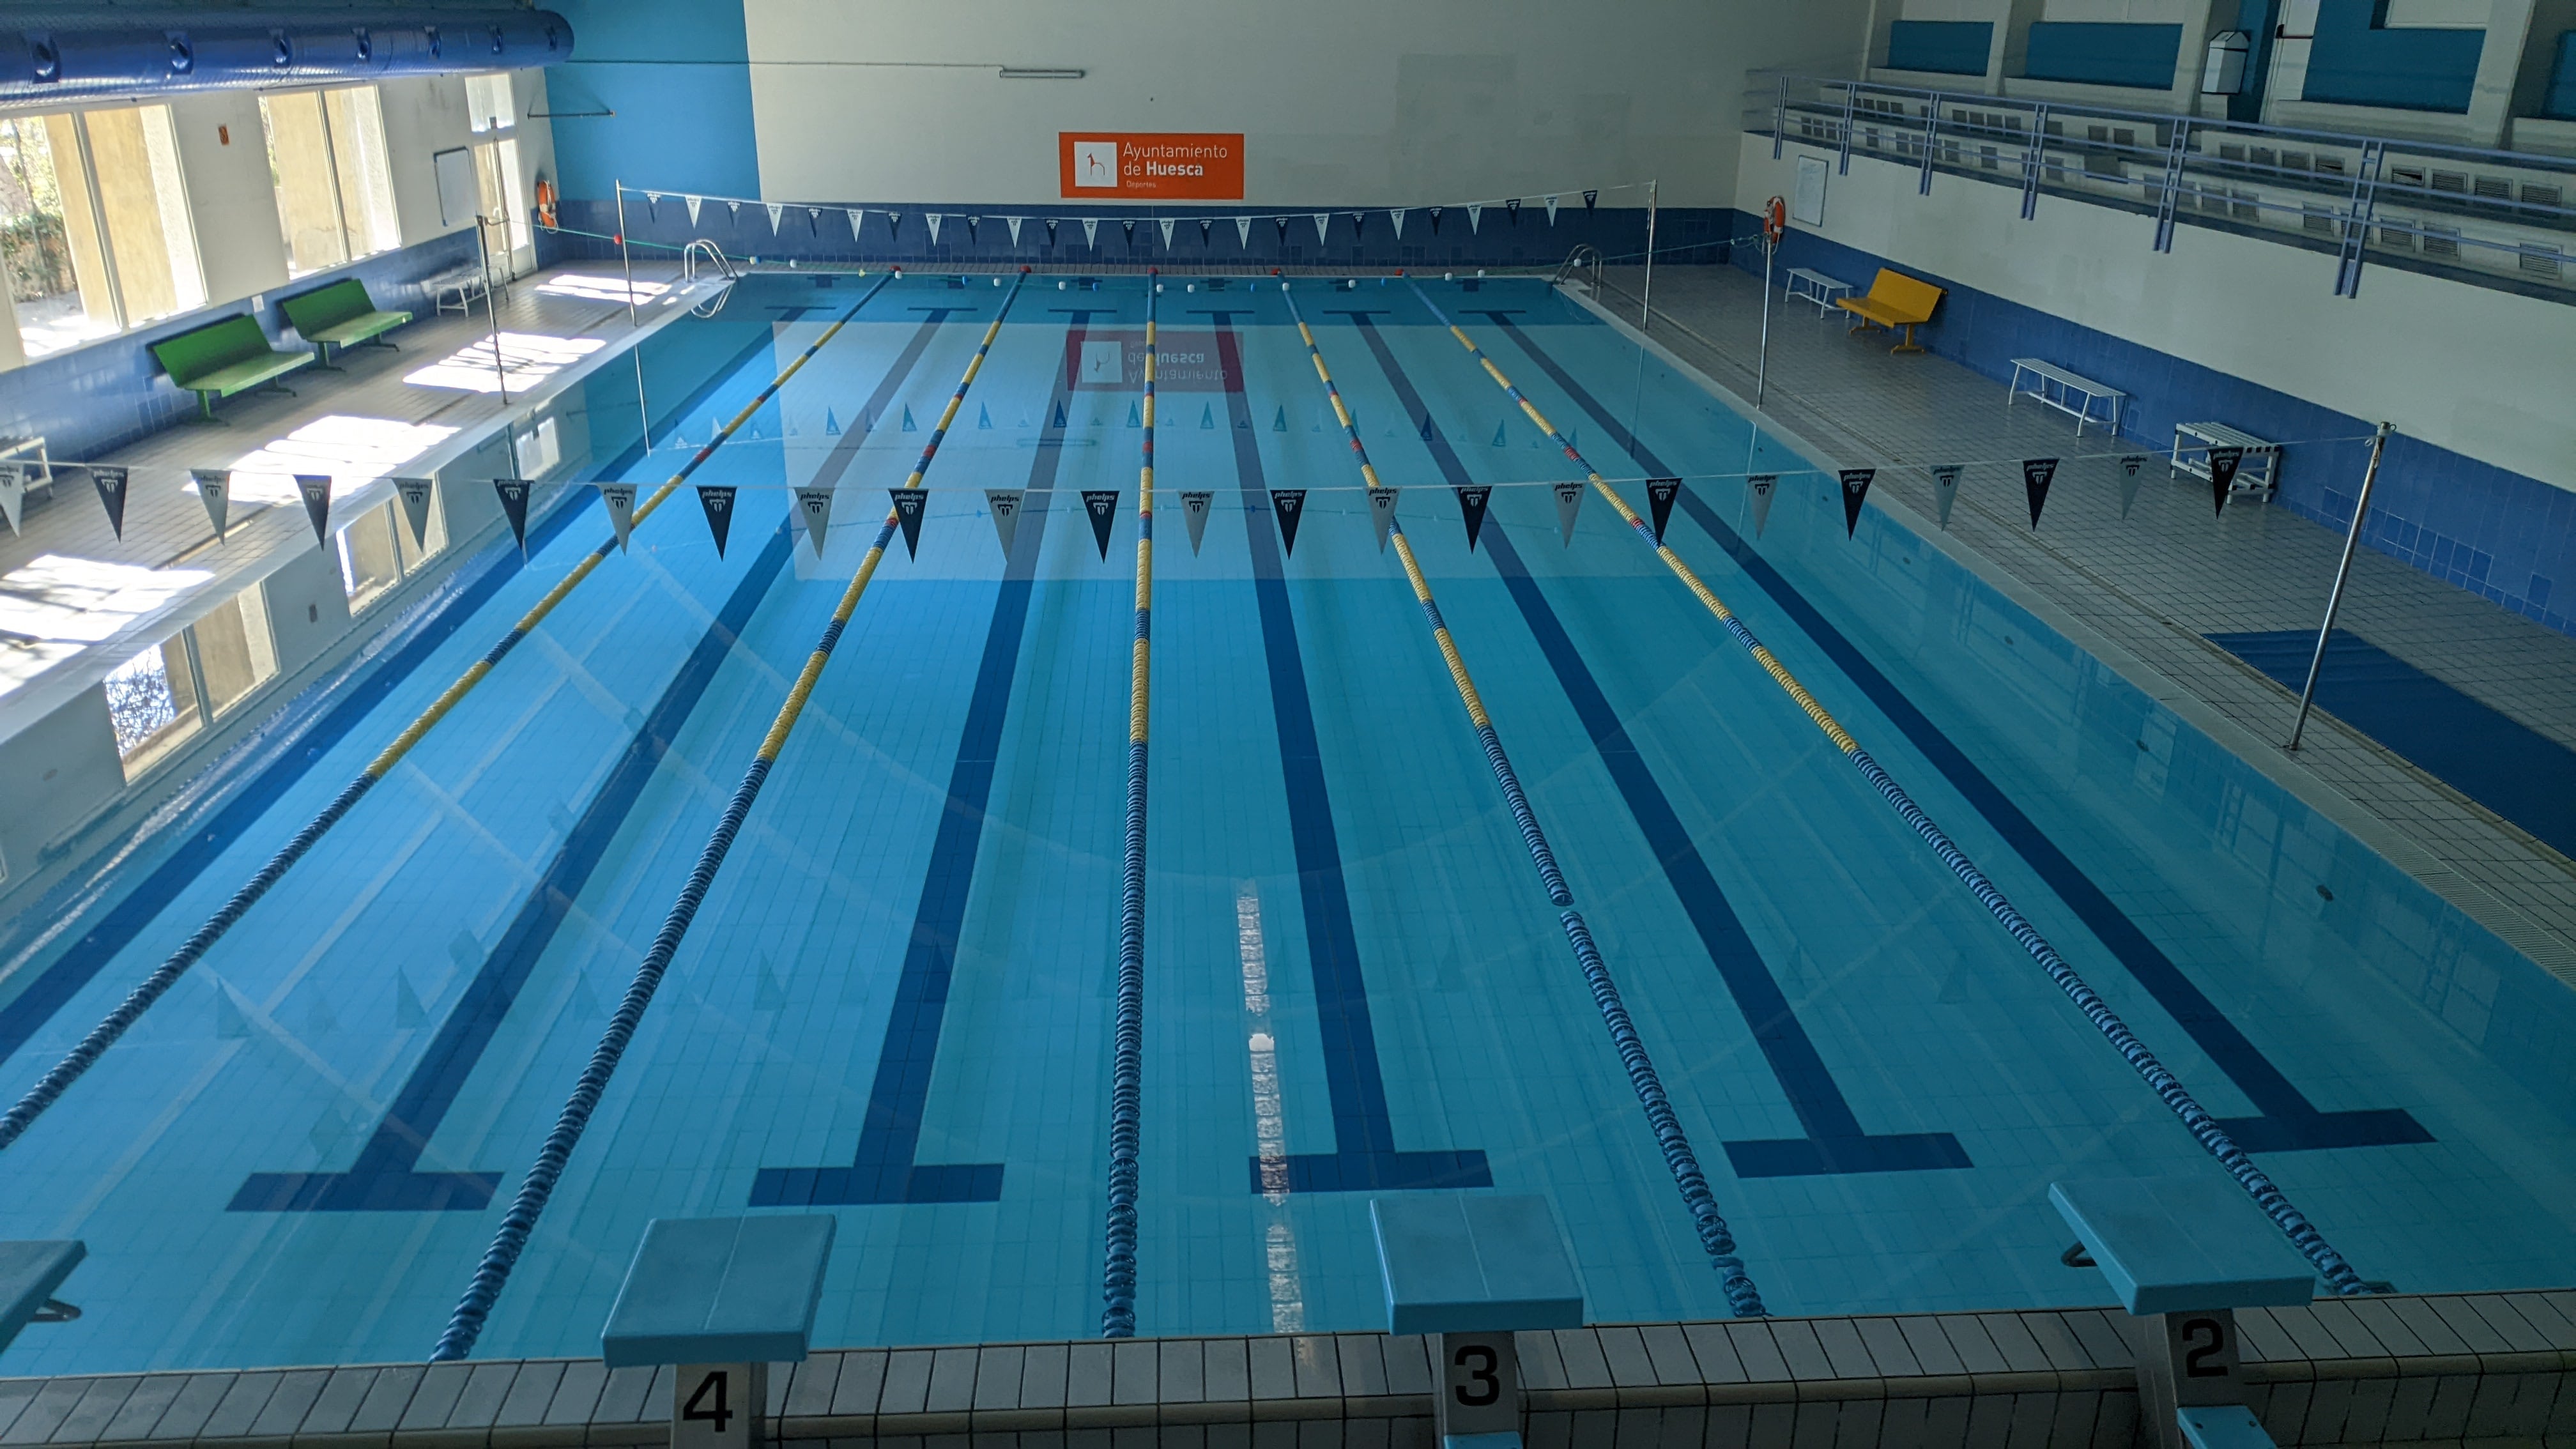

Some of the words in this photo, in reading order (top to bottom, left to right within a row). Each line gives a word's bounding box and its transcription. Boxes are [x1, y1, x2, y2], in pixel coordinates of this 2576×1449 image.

[1123, 142, 1227, 161] Ayuntamiento
[1124, 160, 1141, 176] de
[1146, 161, 1204, 176] Huesca
[1126, 180, 1156, 189] Deportes
[2027, 463, 2056, 472] phelps
[1748, 475, 1776, 483] phelps
[1843, 472, 1871, 482] phelps
[1554, 482, 1583, 491] phelps
[1649, 480, 1678, 488] phelps
[604, 487, 634, 496] phelps
[703, 489, 733, 499] phelps
[1275, 490, 1303, 499] phelps
[1369, 486, 1397, 495] phelps
[801, 491, 830, 501] phelps
[895, 492, 924, 502] phelps
[990, 494, 1020, 503] phelps
[1087, 493, 1115, 502] phelps
[1181, 491, 1211, 500] phelps
[2182, 1319, 2228, 1377] 2
[1455, 1345, 1499, 1407] 3
[683, 1371, 733, 1432] 4
